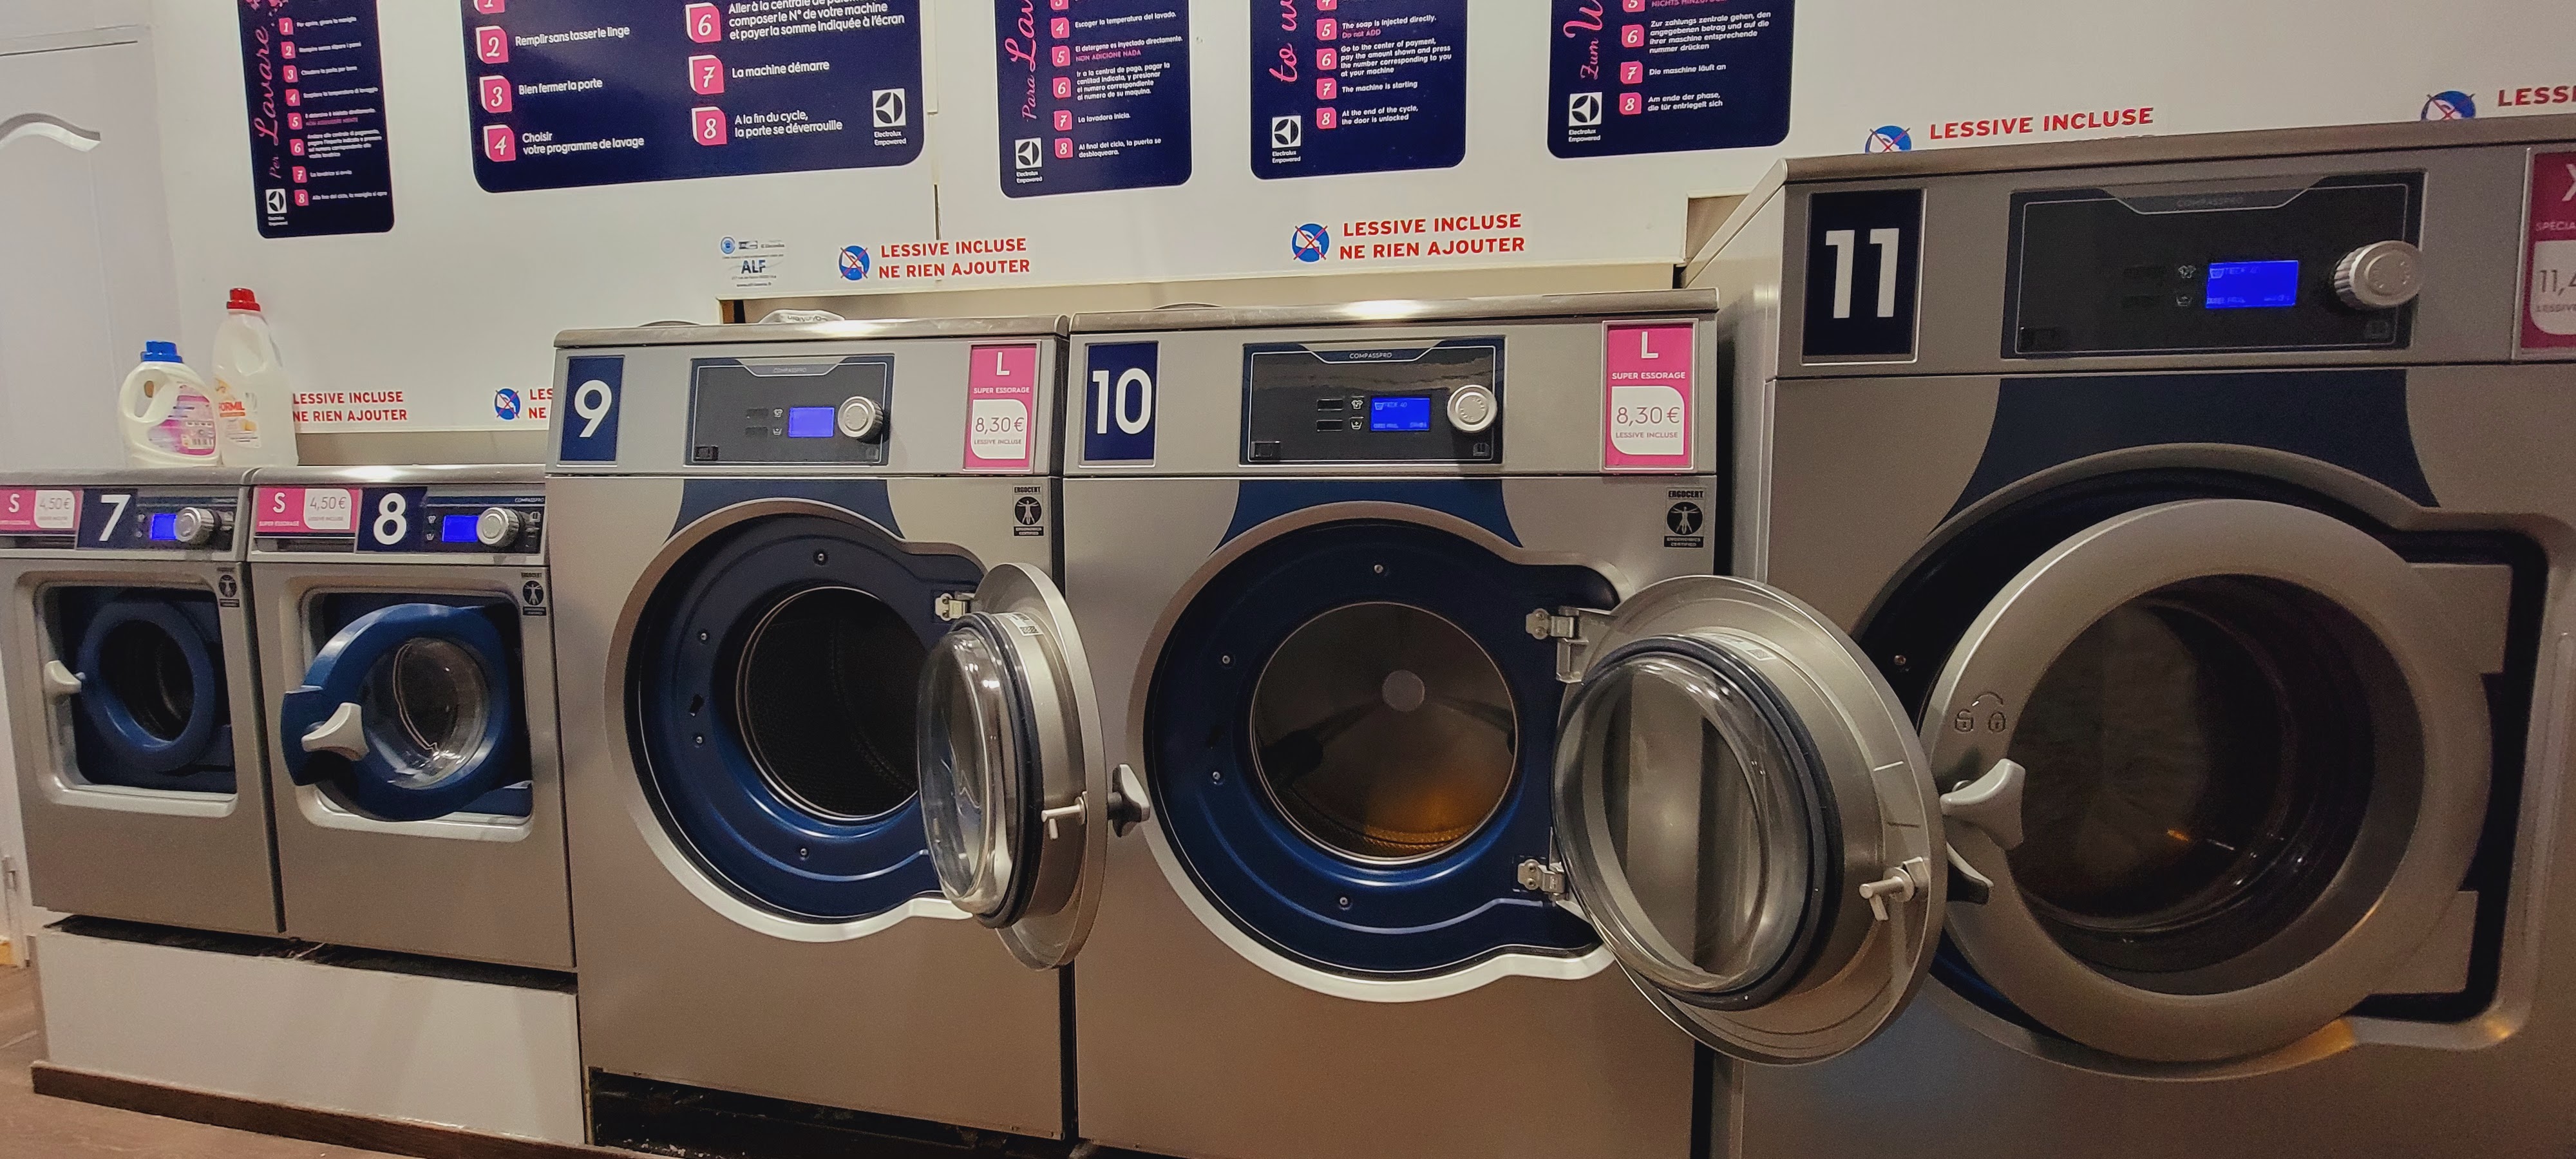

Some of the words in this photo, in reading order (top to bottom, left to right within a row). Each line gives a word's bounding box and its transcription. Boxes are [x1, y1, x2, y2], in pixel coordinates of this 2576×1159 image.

[729, 3, 750, 14] Aller
[750, 1, 758, 12] à
[760, 1, 769, 10] la
[771, 0, 810, 10] centrale
[729, 14, 777, 27] composer
[779, 12, 787, 22] le
[803, 8, 817, 19] de
[817, 6, 843, 18] votre
[845, 3, 887, 15] machine
[698, 14, 712, 35] 6
[730, 29, 739, 39] et
[741, 28, 769, 41] payer
[770, 26, 779, 35] la
[781, 24, 817, 35] somme
[818, 19, 861, 32] indiquée
[863, 17, 869, 26] à
[1056, 23, 1064, 35] 4
[1321, 23, 1331, 37] 5
[515, 34, 548, 46] Remplir
[549, 33, 569, 42] sans
[570, 30, 597, 41] tasser
[598, 28, 606, 37] le
[607, 27, 630, 38] linge
[1627, 30, 1638, 43] 6
[486, 37, 500, 57] 2
[1057, 51, 1065, 63] 5
[1269, 42, 1298, 82] to
[1321, 53, 1332, 66] 6
[1580, 37, 1599, 80] Zum
[703, 66, 715, 88] 7
[732, 68, 744, 78] La
[745, 65, 786, 77] machine
[788, 62, 829, 73] démarre
[1627, 66, 1638, 80] 7
[254, 26, 278, 146] Lavare
[519, 85, 538, 95] Bien
[539, 83, 567, 93] fermer
[568, 80, 576, 90] la
[578, 79, 602, 91] porte
[1058, 82, 1066, 95] 6
[1323, 82, 1332, 96] 7
[491, 86, 503, 107] 3
[1021, 75, 1037, 121] Para
[1625, 97, 1634, 111] 8
[1673, 101, 1707, 109] entriegelt
[1697, 93, 1720, 102] phase,
[2498, 85, 2576, 107] LESSI
[735, 115, 742, 124] A
[743, 115, 752, 124] la
[754, 114, 764, 123] fin
[766, 113, 779, 122] du
[781, 111, 808, 124] cycle,
[1059, 115, 1067, 127] 7
[1321, 112, 1331, 126] 8
[1930, 117, 2033, 139] LESSIVE
[2043, 108, 2153, 131] INCLUSE
[522, 133, 552, 142] Choisir
[704, 118, 716, 139] 8
[735, 127, 744, 137] la
[746, 126, 772, 138] porte
[773, 126, 785, 135] se
[787, 120, 842, 133] déverrouille
[495, 135, 506, 155] 4
[523, 145, 545, 155] votre
[547, 142, 598, 155] programme
[599, 139, 611, 149] de
[612, 138, 644, 148] lavage
[875, 138, 906, 146] Empowered
[1060, 143, 1067, 155] 8
[1344, 220, 1425, 236] LESSIVE
[1434, 214, 1520, 232] INCLUSE
[2536, 221, 2576, 231] SPECIA
[882, 243, 949, 258] LESSIVE
[956, 238, 1025, 254] INCLUSE
[1340, 245, 1364, 259] NE
[1374, 243, 1419, 258] RIEN
[1428, 238, 1524, 255] AJOUTER
[741, 259, 766, 274] ALF
[880, 266, 900, 278] NE
[907, 264, 945, 277] RIEN
[952, 259, 1029, 276] AJOUTER
[1825, 228, 1900, 318] 11
[1641, 331, 1658, 359] L
[996, 352, 1010, 375] L
[293, 393, 344, 404] LESSIVE
[350, 391, 402, 403] INCLUSE
[1092, 368, 1152, 435] 10
[293, 411, 308, 422] NE
[314, 411, 343, 421] RIEN
[348, 410, 407, 421] AJOUTER
[529, 408, 546, 419] NE
[574, 380, 612, 438] 9
[1616, 406, 1662, 427] 8,30
[1667, 406, 1680, 424] €
[975, 417, 1010, 435] 8,30
[1014, 417, 1024, 432] €
[8, 493, 20, 513] S
[39, 497, 62, 511] 4,50
[273, 492, 286, 513] S
[310, 496, 336, 511] 4,50
[339, 496, 346, 509] €
[99, 495, 131, 542] 7
[373, 493, 407, 545] 8
